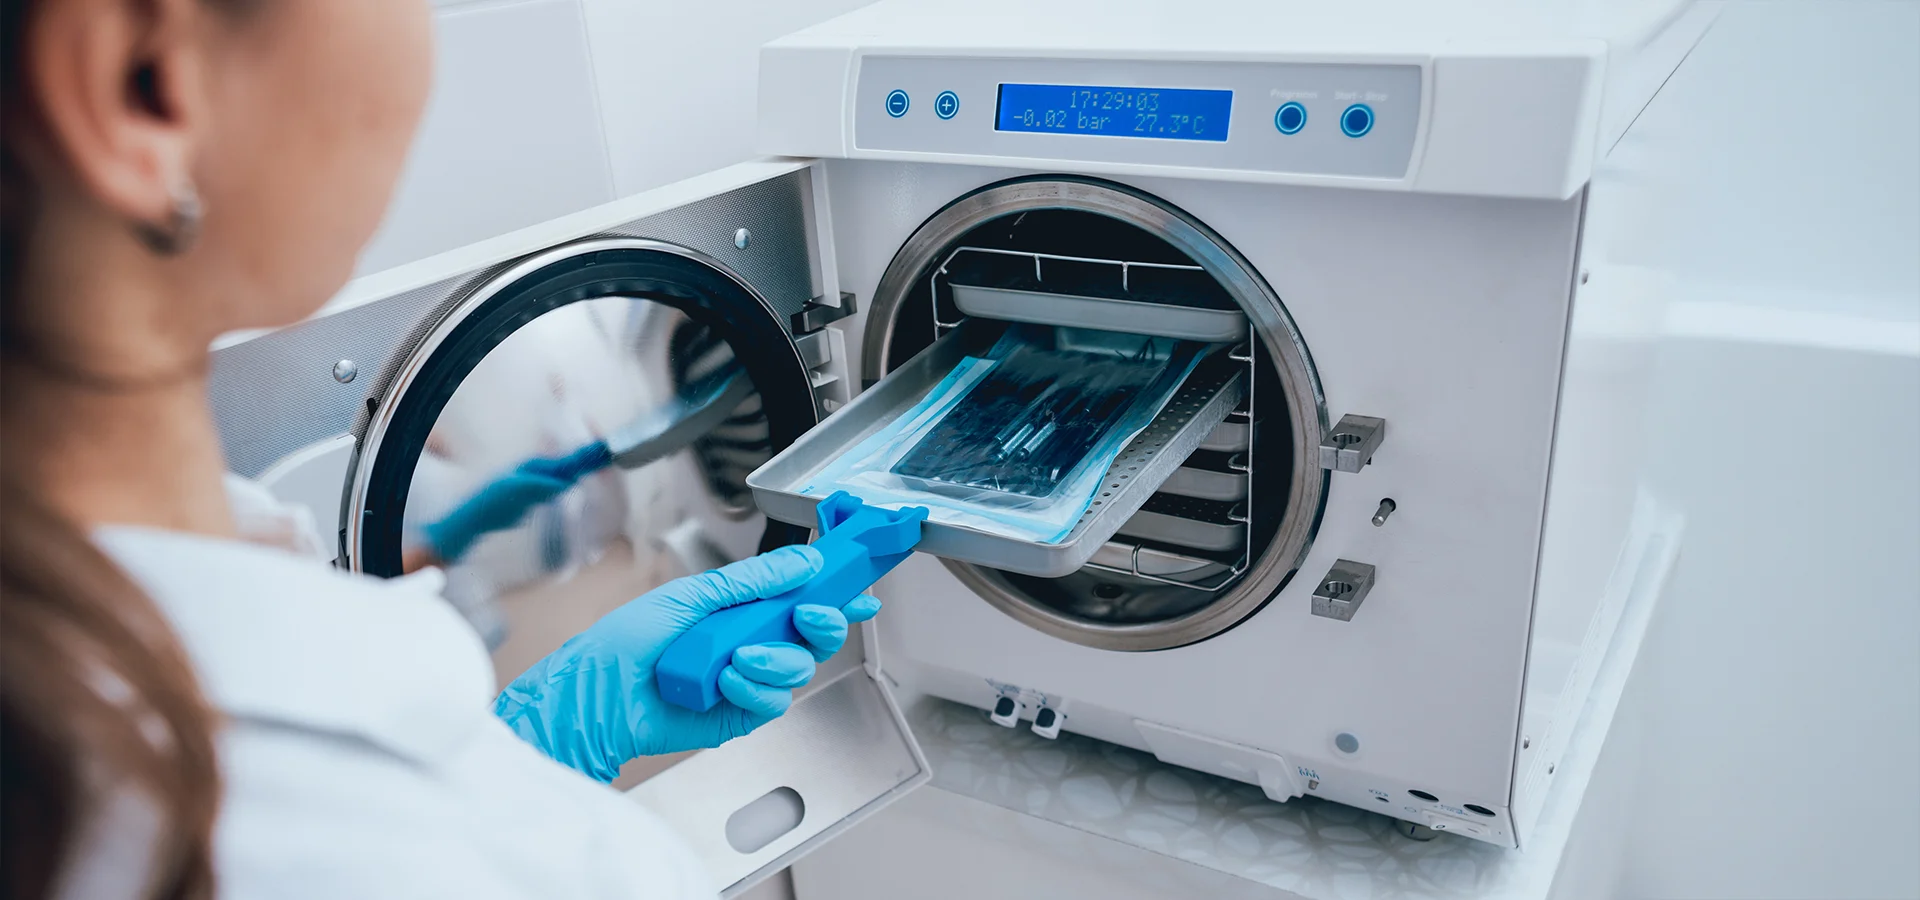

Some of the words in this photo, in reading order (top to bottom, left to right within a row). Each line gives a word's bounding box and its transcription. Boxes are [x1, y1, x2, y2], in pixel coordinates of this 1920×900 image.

[1070, 91, 1160, 111] 17:29:03
[1013, 109, 1067, 128] -0.02
[1077, 112, 1111, 130] bar
